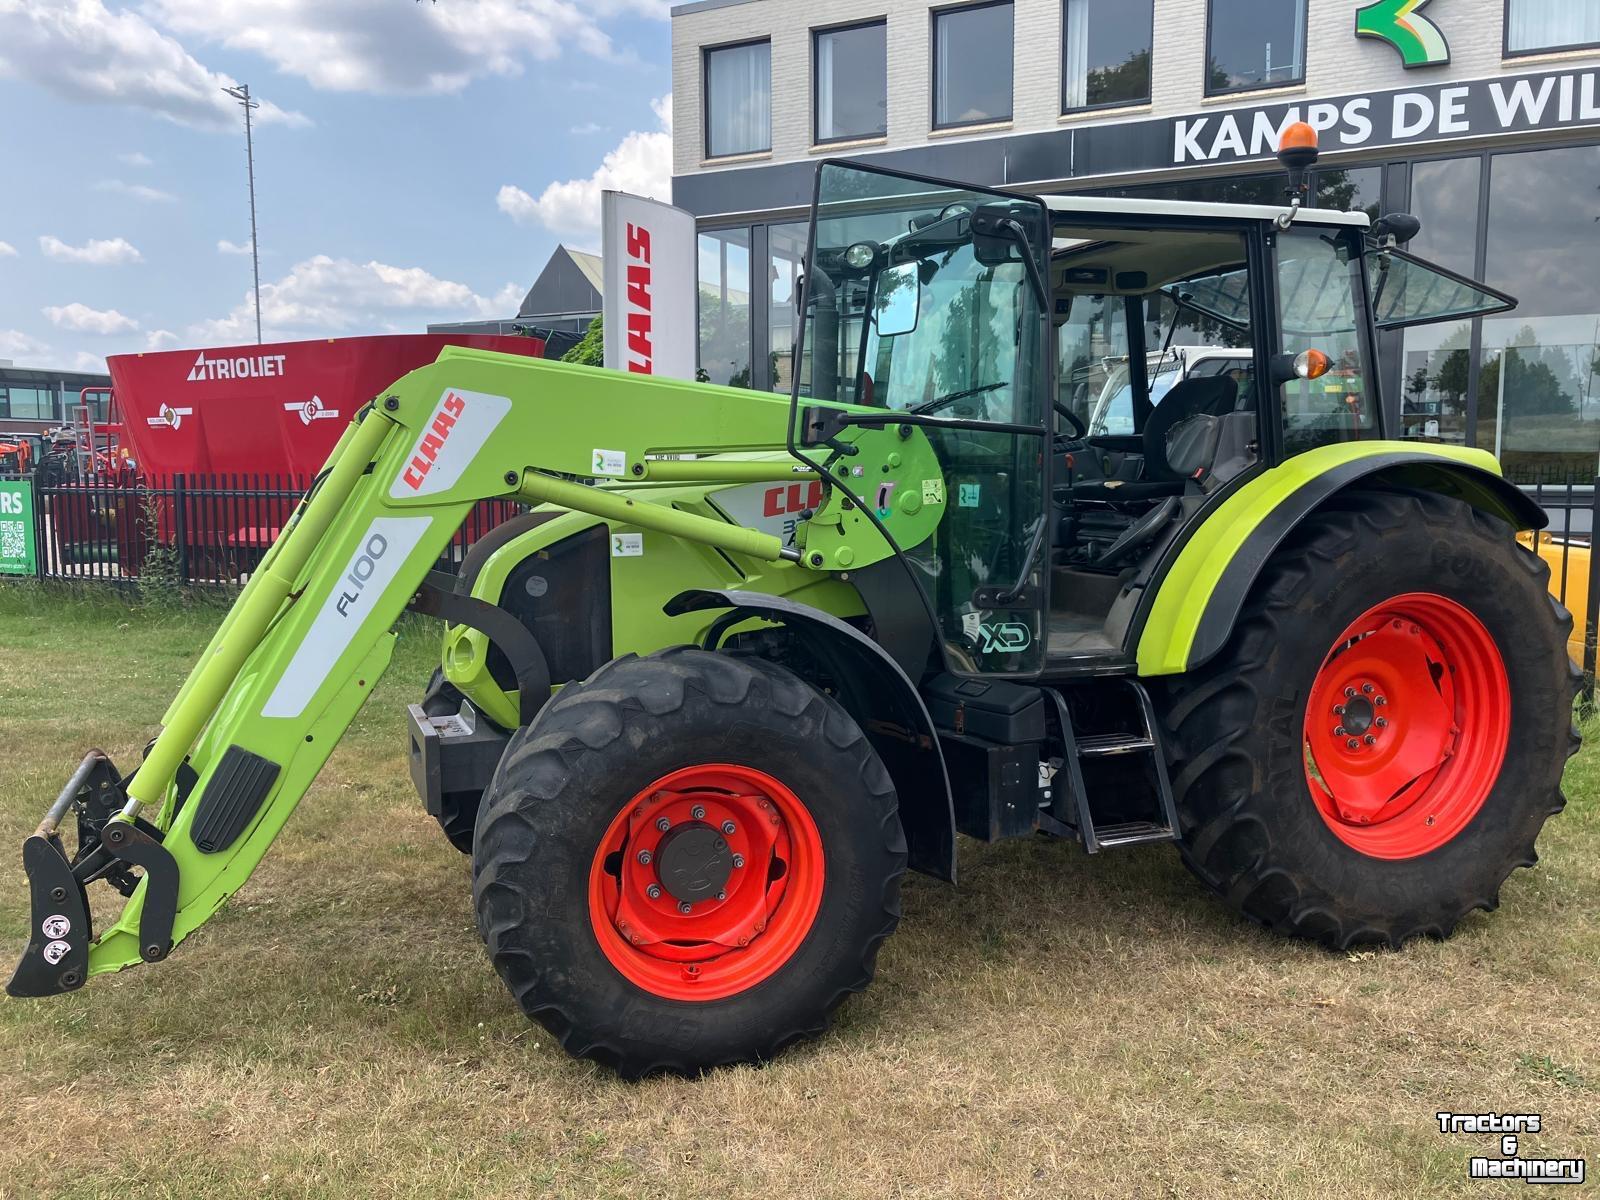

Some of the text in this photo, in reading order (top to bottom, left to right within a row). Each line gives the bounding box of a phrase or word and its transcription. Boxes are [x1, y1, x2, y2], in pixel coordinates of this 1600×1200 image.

[1174, 73, 1600, 163] KAMPS DE WIL
[205, 355, 286, 380] TRIOLIET
[403, 392, 466, 491] CLAAS
[978, 622, 1031, 653] XD
